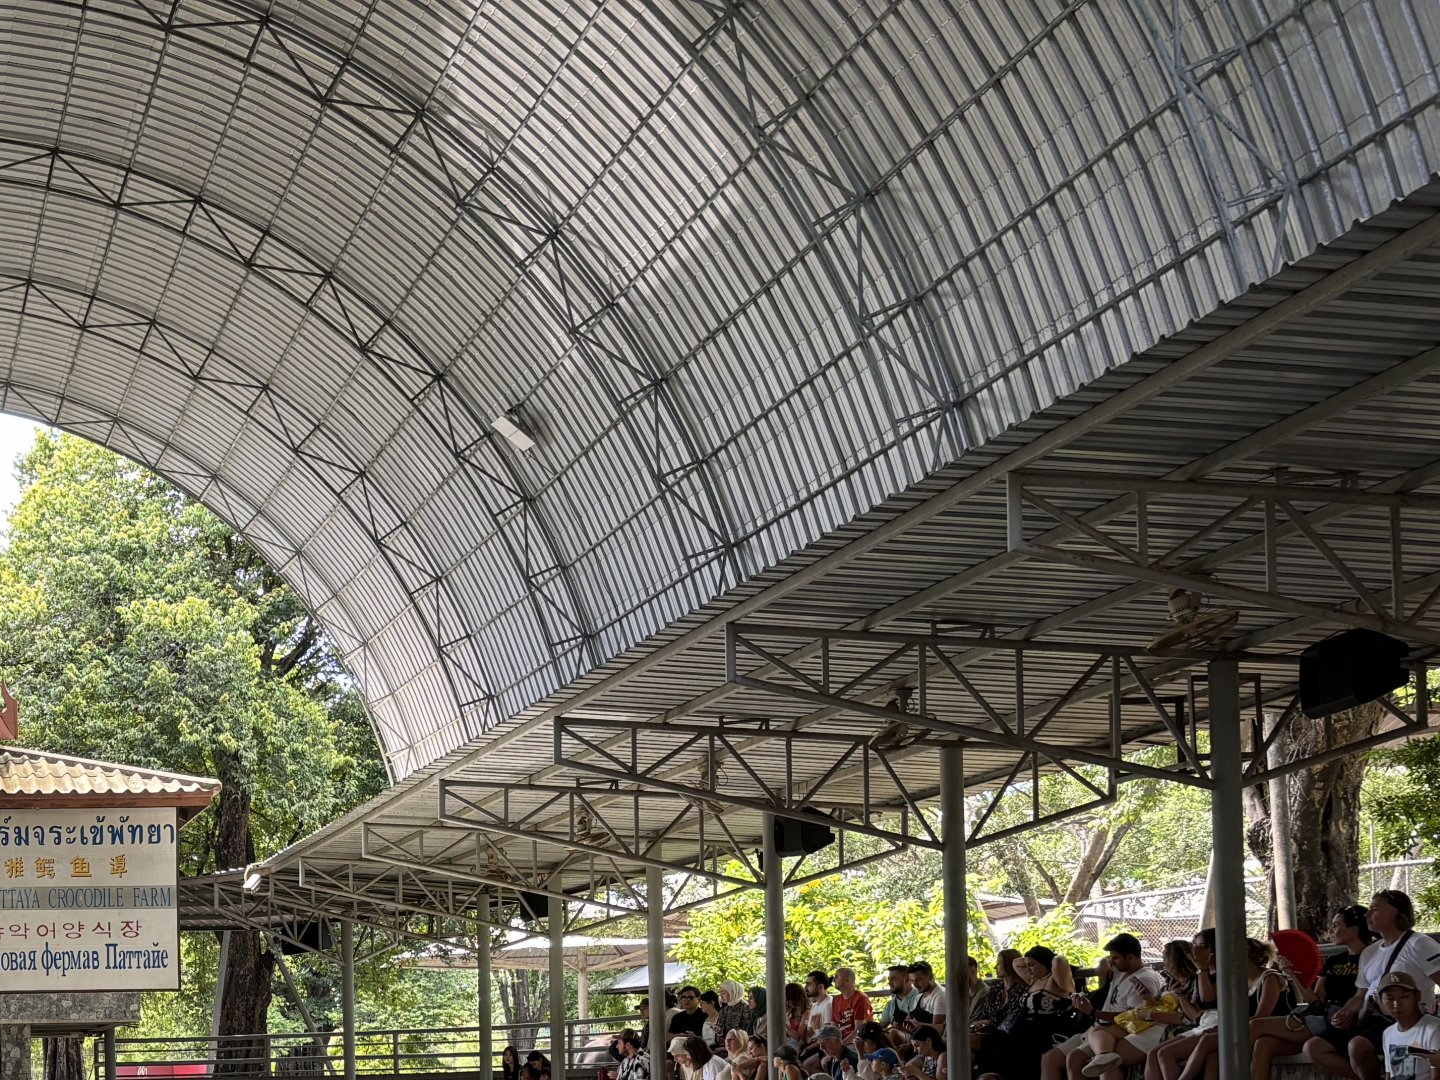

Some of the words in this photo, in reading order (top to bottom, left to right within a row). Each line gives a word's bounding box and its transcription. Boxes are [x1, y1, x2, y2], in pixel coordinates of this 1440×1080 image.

[48, 888, 124, 908] CROCODILE
[133, 887, 171, 907] FARM
[105, 942, 169, 970] Паттайе
